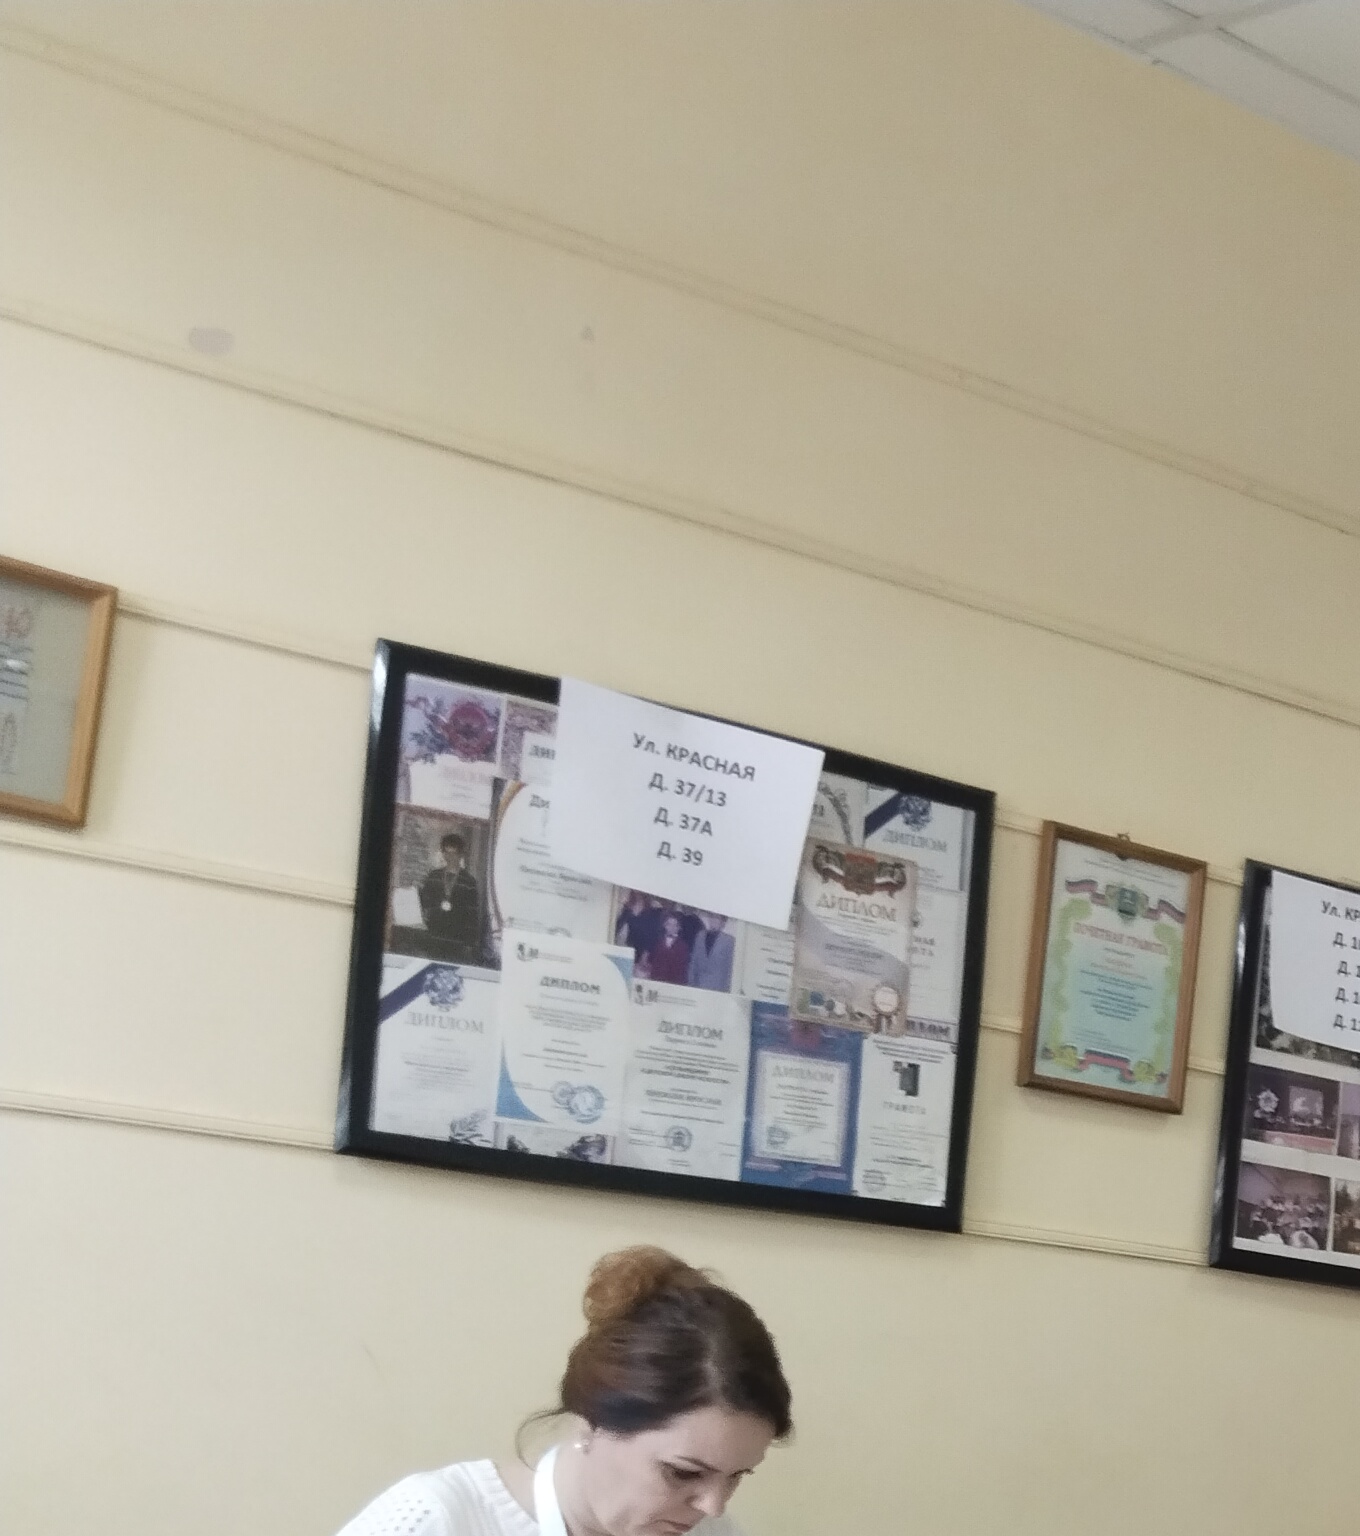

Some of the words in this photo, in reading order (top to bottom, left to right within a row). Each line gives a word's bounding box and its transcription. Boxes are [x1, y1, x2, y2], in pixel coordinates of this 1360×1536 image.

[633, 732, 660, 755] Ул.
[666, 743, 756, 781] КРАСНАЯ
[648, 772, 668, 792] Д.
[674, 779, 727, 807] 37/13
[653, 806, 673, 827] Д.
[679, 813, 713, 836] 37А
[656, 841, 676, 861] Д.
[682, 847, 704, 866] 39
[1321, 900, 1341, 918] Ул.
[1332, 932, 1347, 950] Д.
[1337, 960, 1351, 977] Д.
[1335, 987, 1349, 1004] Д.
[1333, 1014, 1347, 1031] Д.
